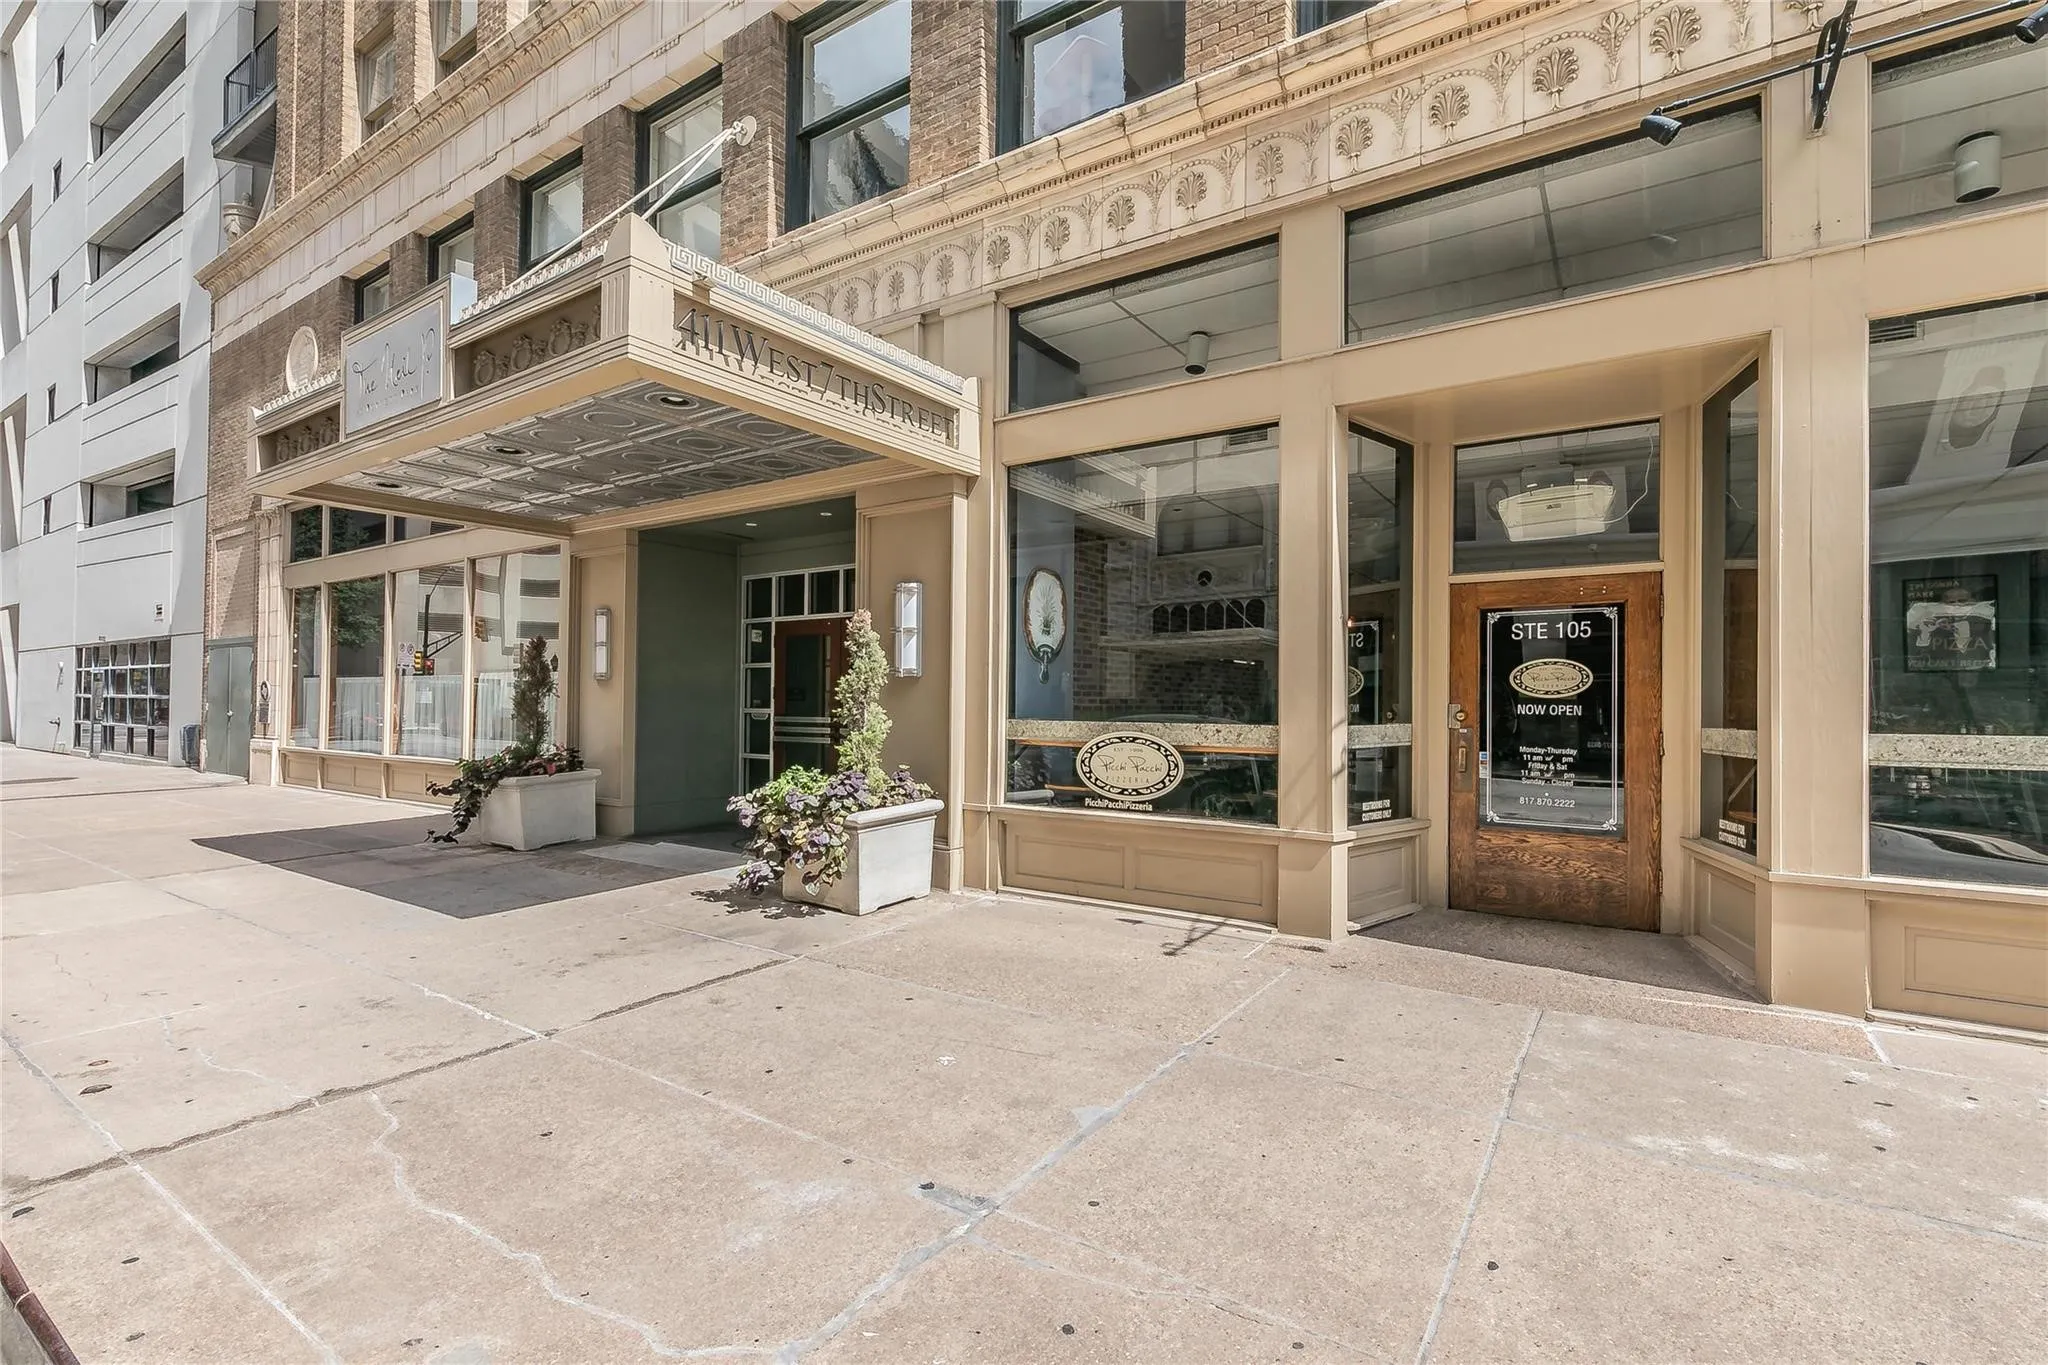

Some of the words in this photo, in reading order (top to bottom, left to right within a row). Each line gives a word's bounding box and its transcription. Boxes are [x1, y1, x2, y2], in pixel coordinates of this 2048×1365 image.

[676, 308, 729, 356] 411
[1511, 622, 1549, 641] STE
[1555, 620, 1592, 639] 105
[1517, 704, 1546, 716] NOW
[1549, 704, 1583, 717] OPEN
[1519, 745, 1578, 757] Monday-Thursday
[1097, 755, 1127, 773] Picchi
[1127, 755, 1164, 774] Pacchi
[1562, 756, 1574, 764] pm
[1519, 796, 1576, 808] 817.870.2222
